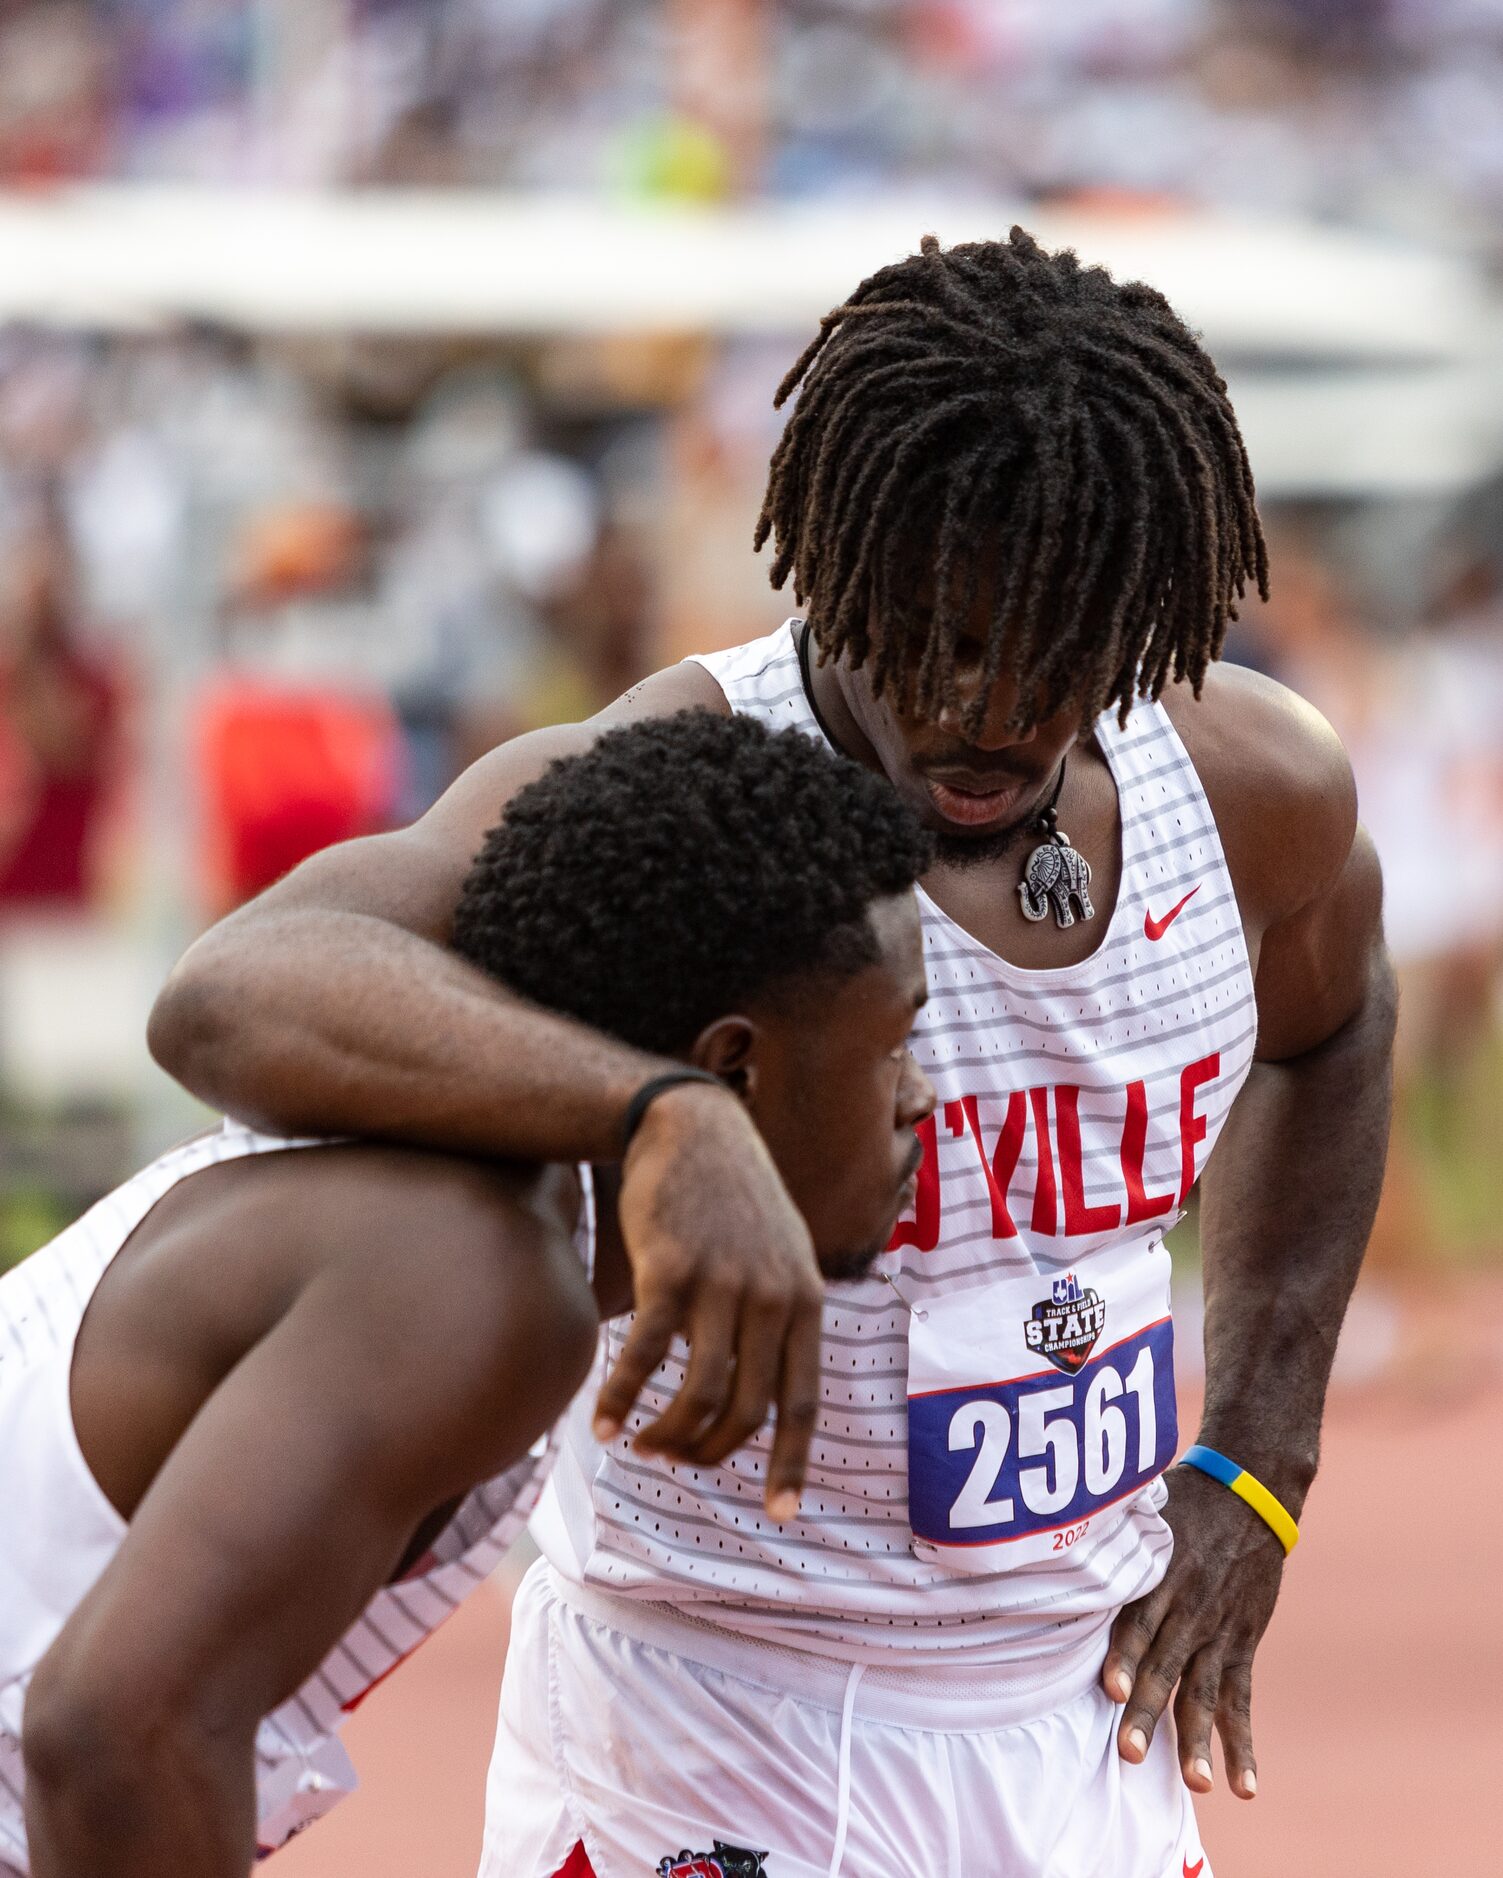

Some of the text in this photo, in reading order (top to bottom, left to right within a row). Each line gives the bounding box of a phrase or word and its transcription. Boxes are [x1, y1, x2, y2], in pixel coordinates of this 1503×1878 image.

[1025, 1301, 1105, 1346] STATE
[1045, 1298, 1092, 1318] TRACK & FIELD
[1044, 1331, 1096, 1353] CHAMPIONSHIPS
[947, 1345, 1157, 1529] 2561
[1052, 1520, 1090, 1551] 2022
